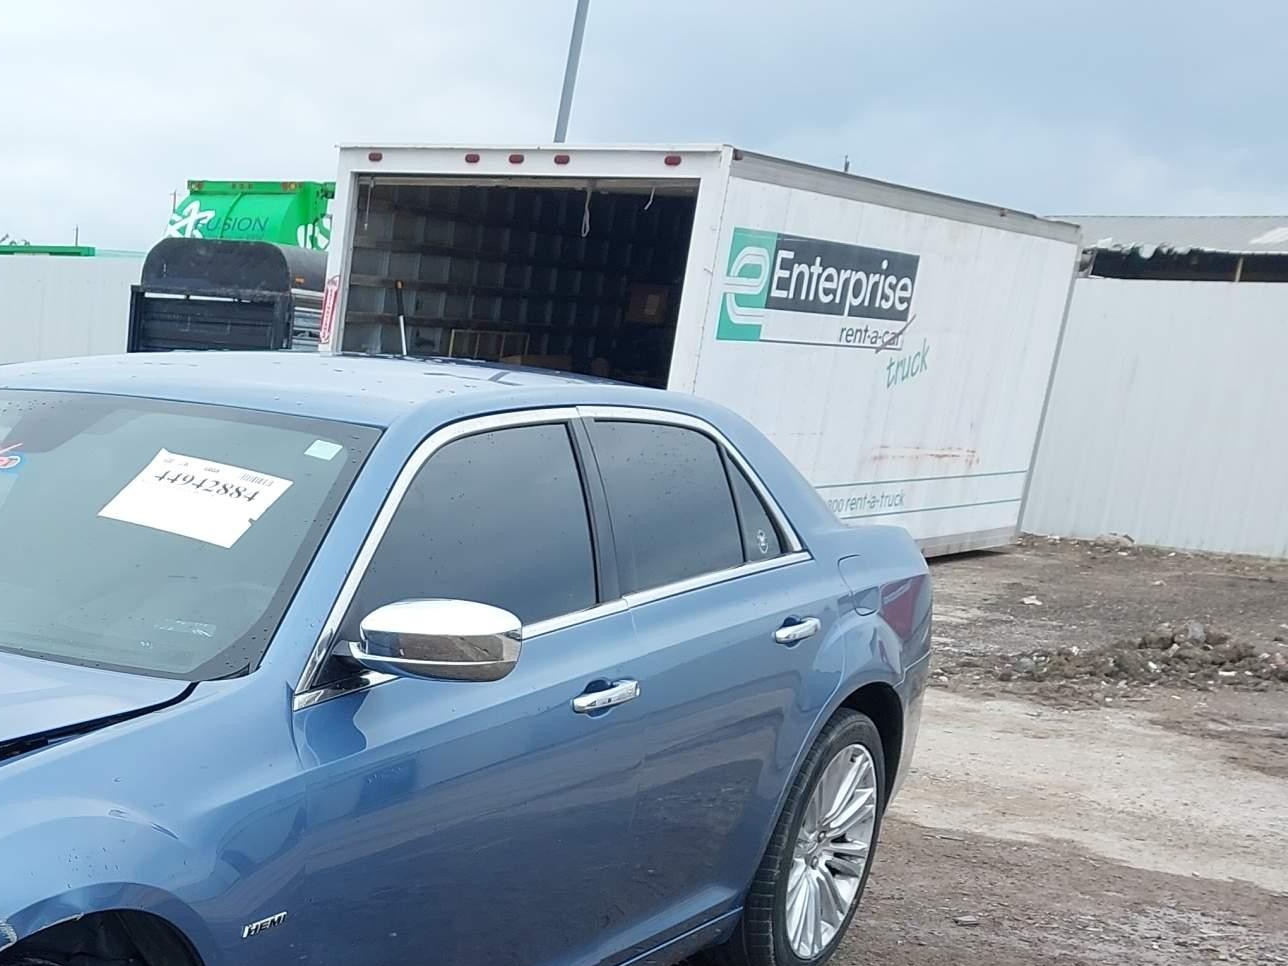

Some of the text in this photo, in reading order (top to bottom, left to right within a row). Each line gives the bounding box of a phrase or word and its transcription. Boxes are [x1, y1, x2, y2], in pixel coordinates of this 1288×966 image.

[770, 250, 912, 317] Enterprise
[839, 325, 902, 347] rent-a-car
[886, 338, 930, 389] truck
[154, 470, 260, 502] 44942884
[845, 489, 905, 512] rent-a-truck
